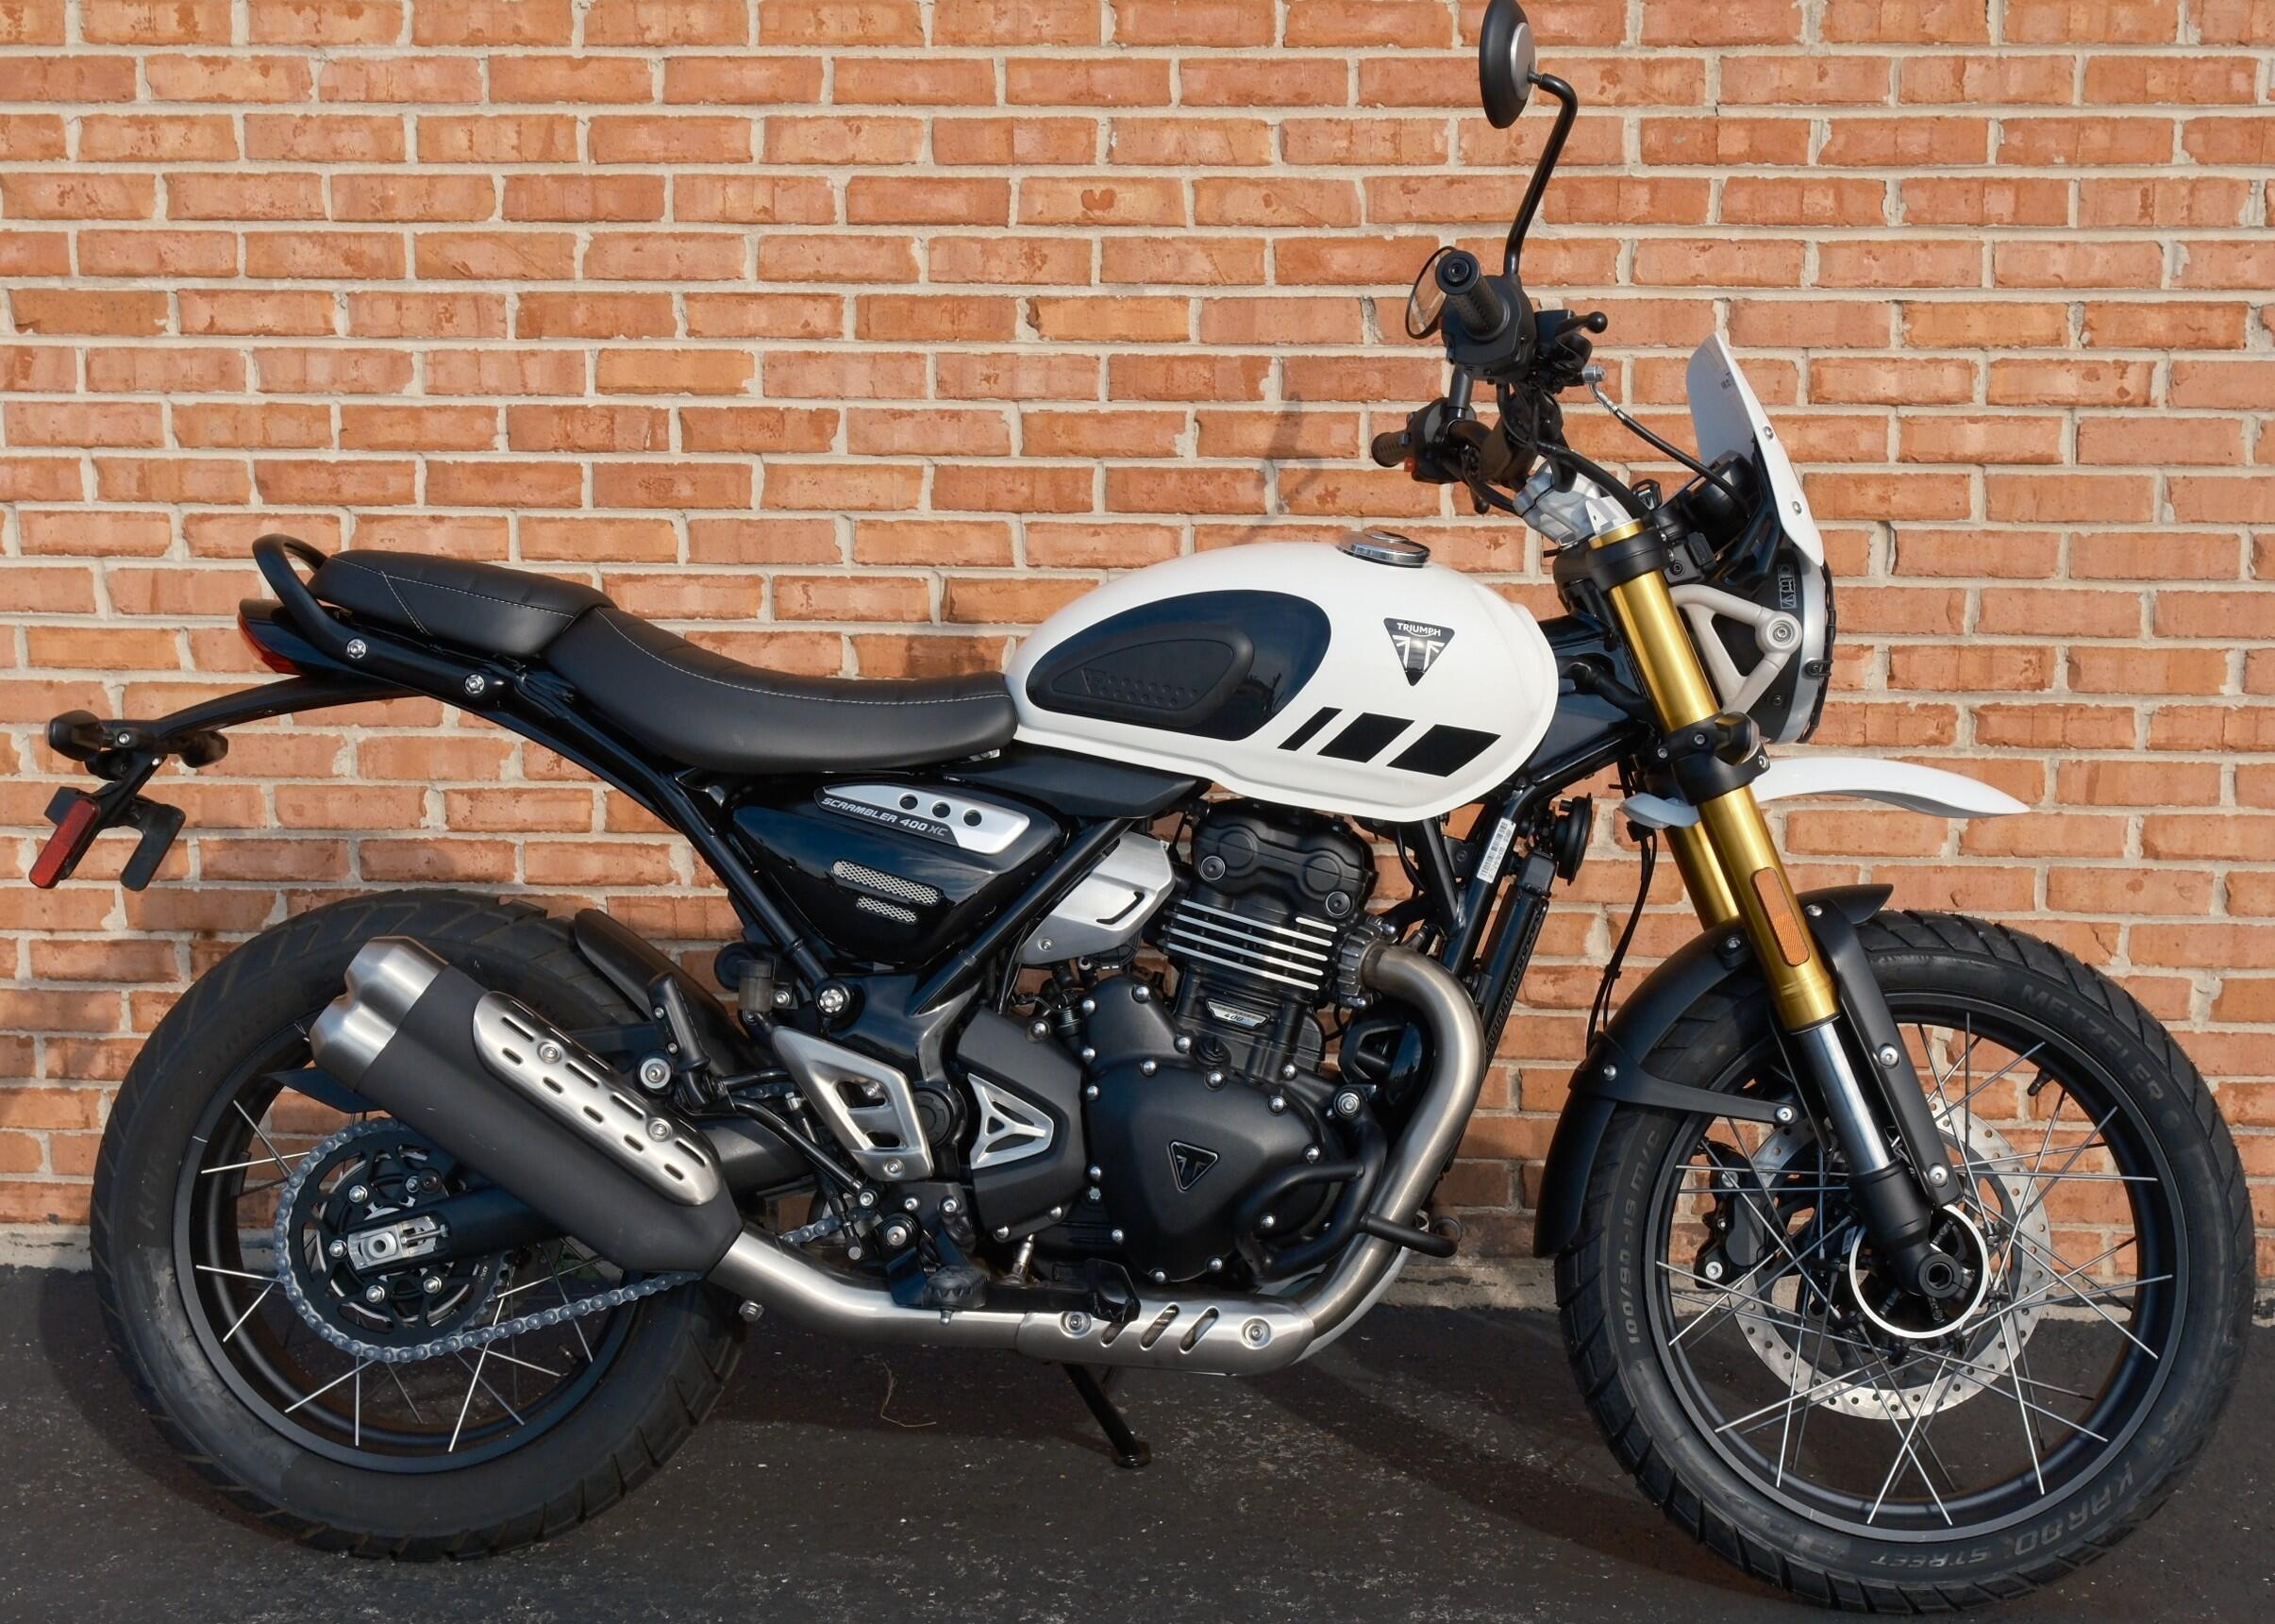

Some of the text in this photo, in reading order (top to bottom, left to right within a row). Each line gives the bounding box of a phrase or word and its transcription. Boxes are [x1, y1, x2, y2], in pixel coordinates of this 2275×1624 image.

[1396, 622, 1442, 637] TRIUMPH
[821, 796, 948, 837] SCRAMBLER 400 XC
[1869, 1461, 2133, 1568] KAROO STREET
